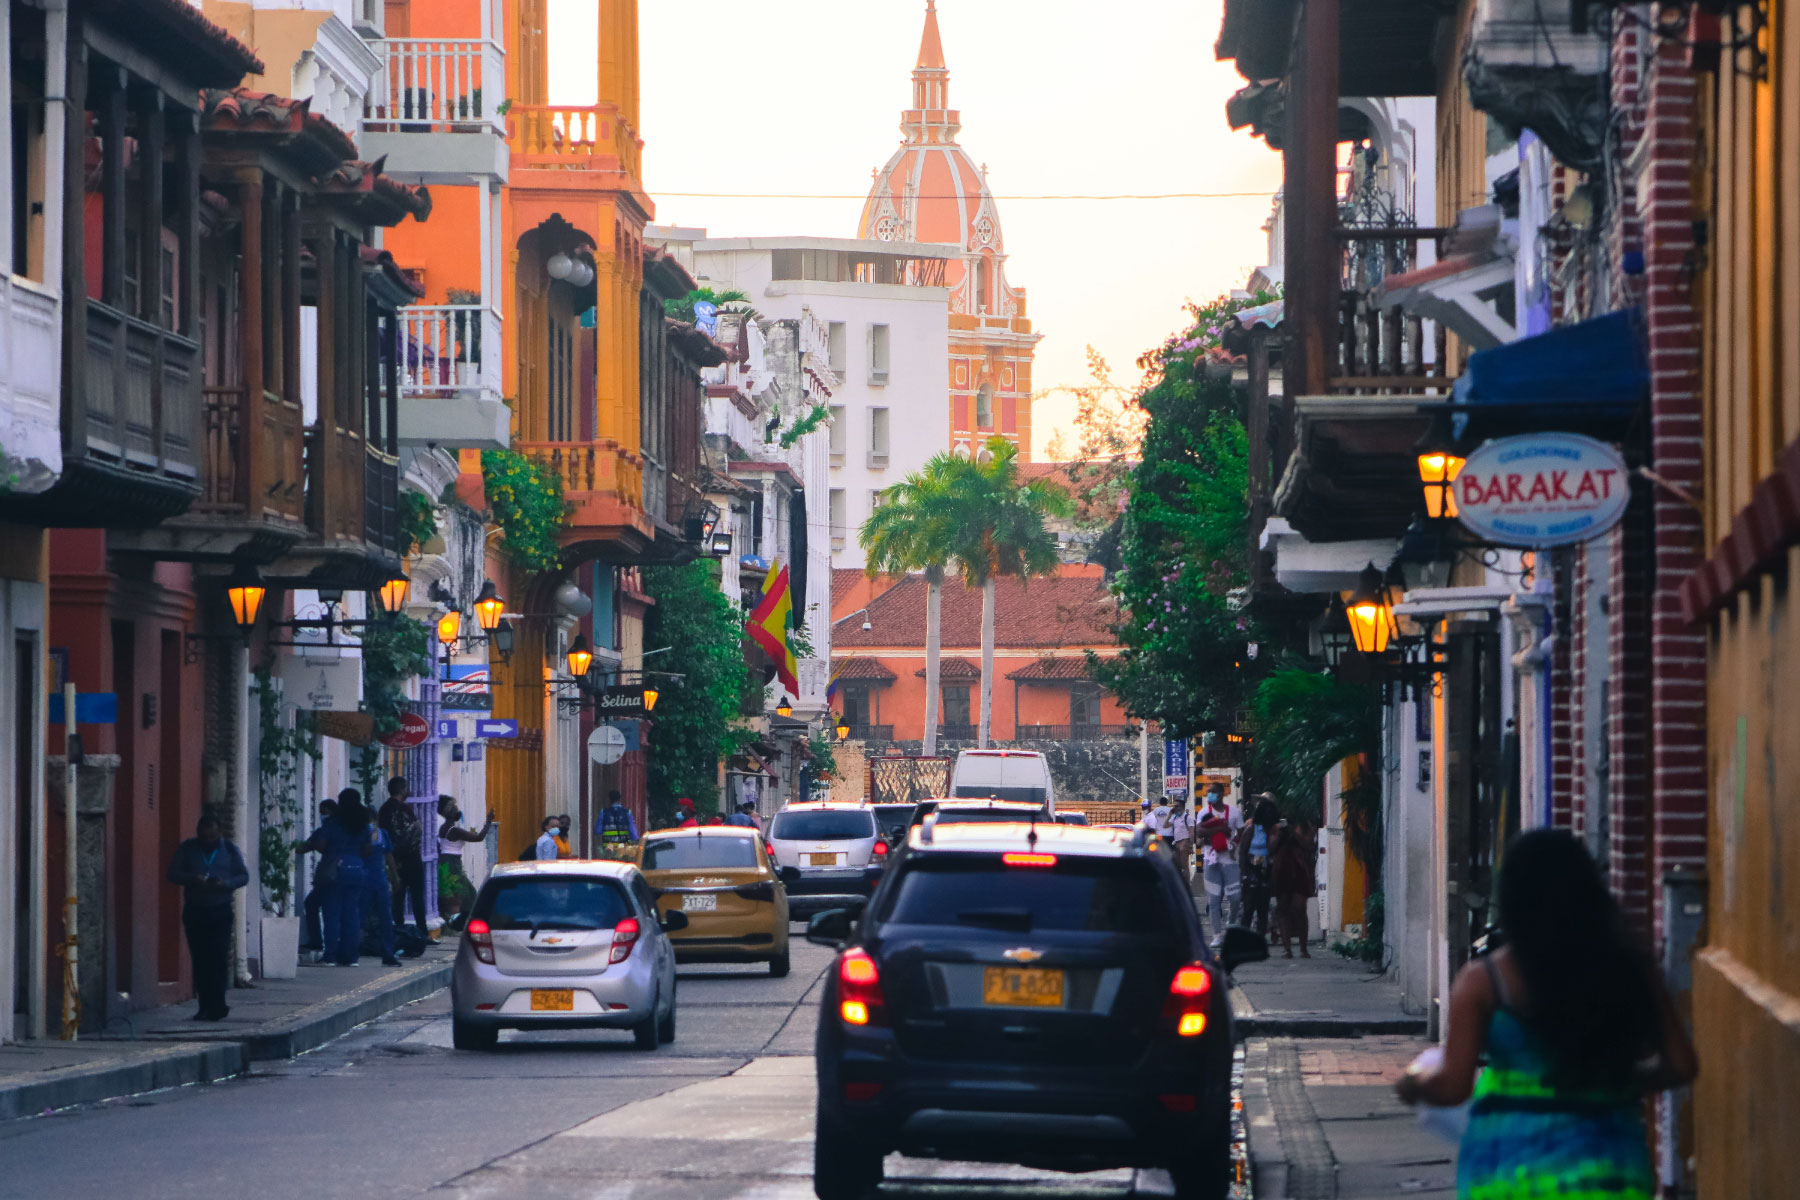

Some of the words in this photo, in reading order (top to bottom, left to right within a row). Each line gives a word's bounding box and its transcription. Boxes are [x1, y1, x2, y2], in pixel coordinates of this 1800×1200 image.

[1462, 469, 1617, 506] BARAKAT
[601, 694, 642, 708] Selina
[400, 723, 426, 733] Fegali
[1166, 777, 1187, 789] ABIERTO
